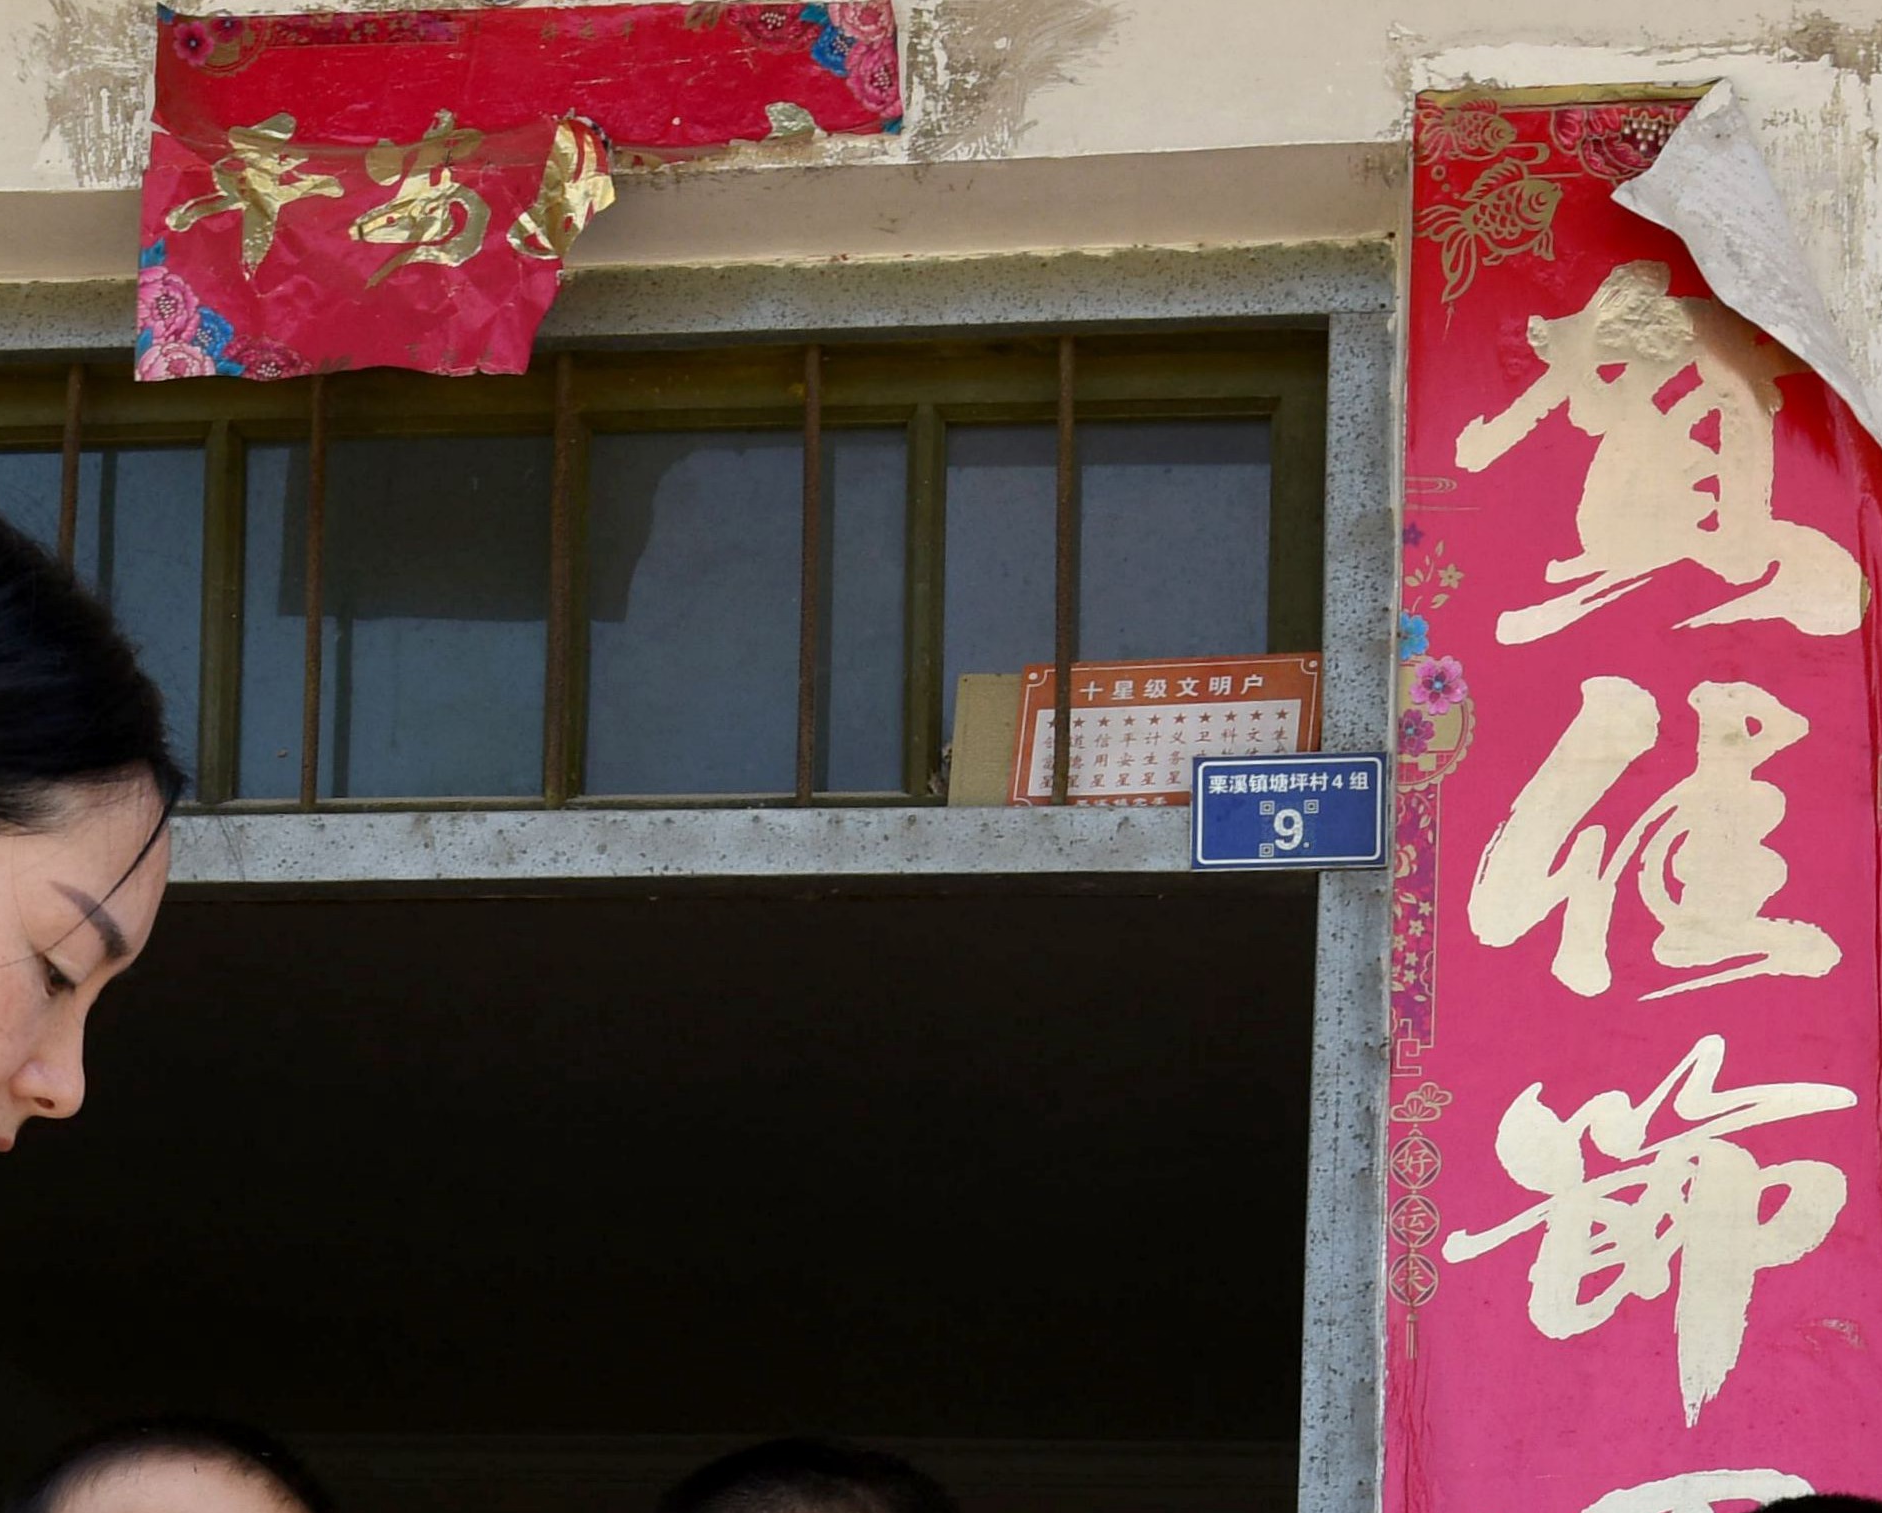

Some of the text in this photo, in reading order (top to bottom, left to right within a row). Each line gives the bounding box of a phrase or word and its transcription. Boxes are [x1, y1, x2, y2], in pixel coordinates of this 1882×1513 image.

[1079, 674, 1263, 701] 十星级文明户
[1273, 808, 1304, 851] 9
[1396, 1149, 1431, 1293] 好运来
